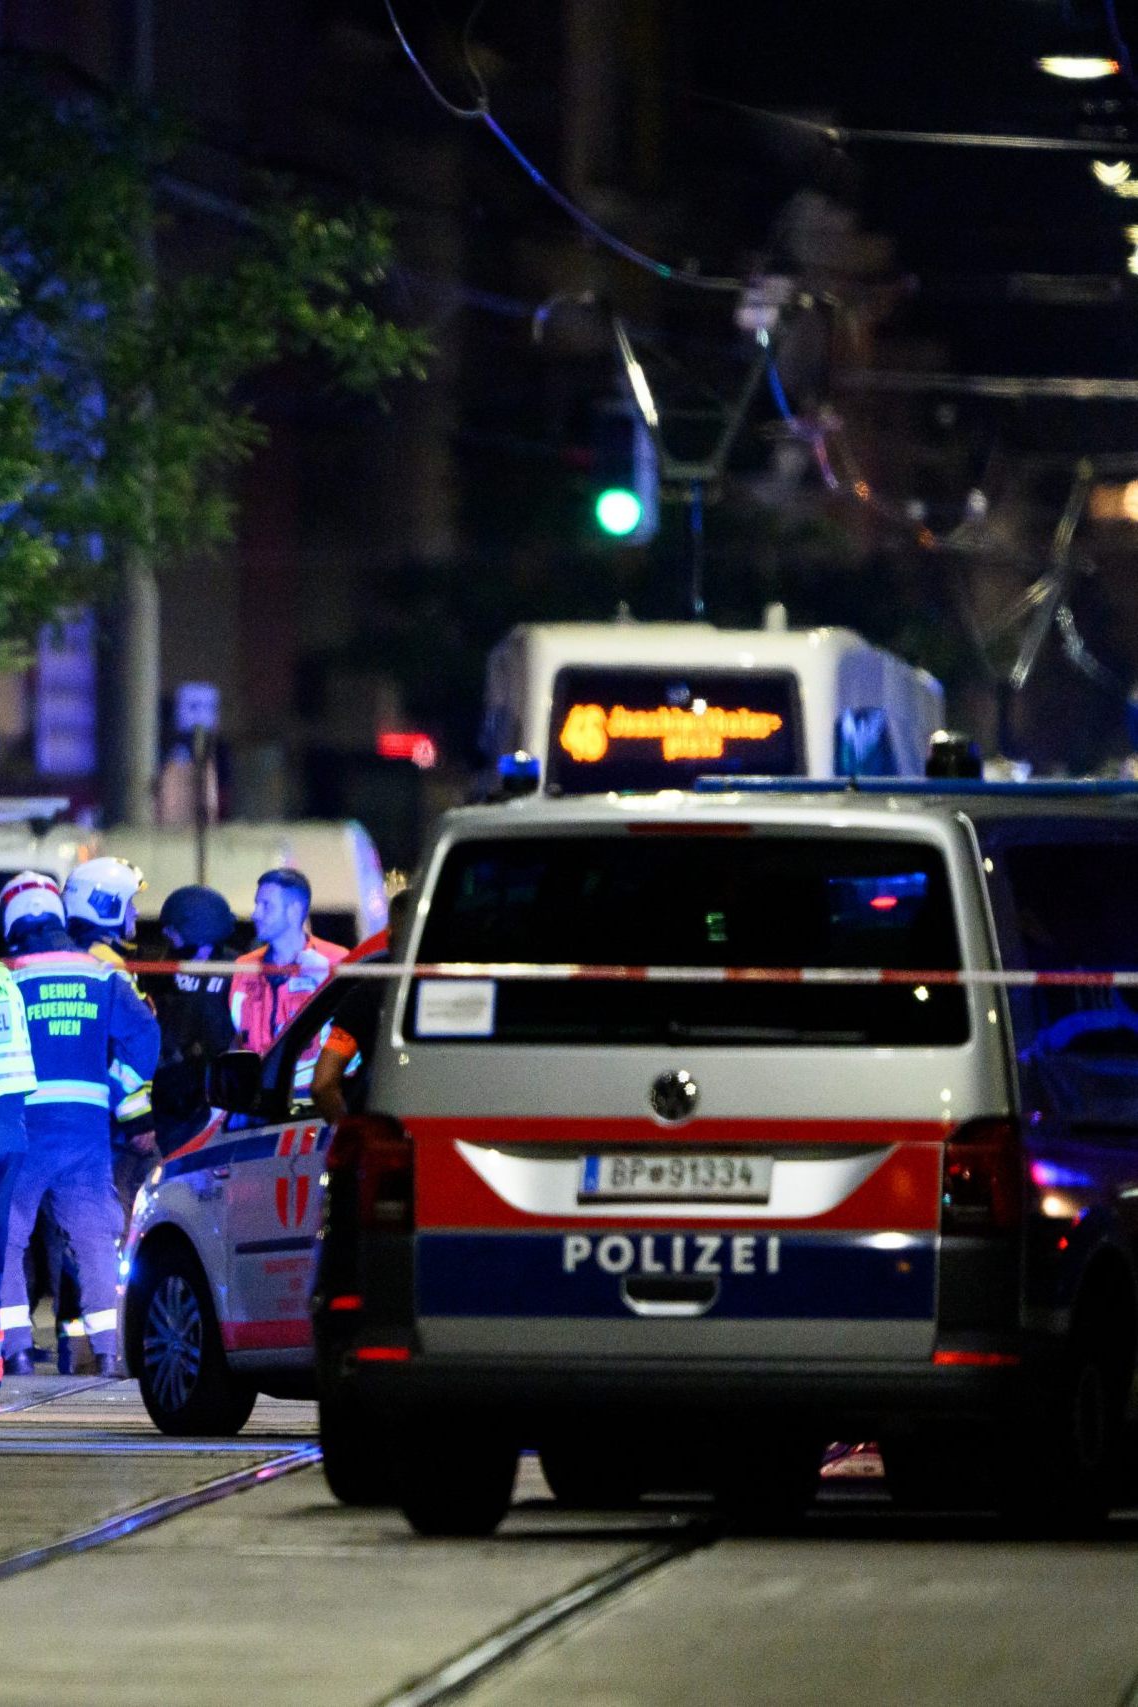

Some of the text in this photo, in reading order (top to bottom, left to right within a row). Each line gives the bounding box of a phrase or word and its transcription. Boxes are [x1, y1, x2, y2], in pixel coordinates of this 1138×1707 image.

[39, 983, 86, 1000] BERUFS
[27, 1001, 98, 1021] FEUERWEHR
[48, 1019, 81, 1035] WIEN
[563, 1235, 780, 1274] POLIZEI
